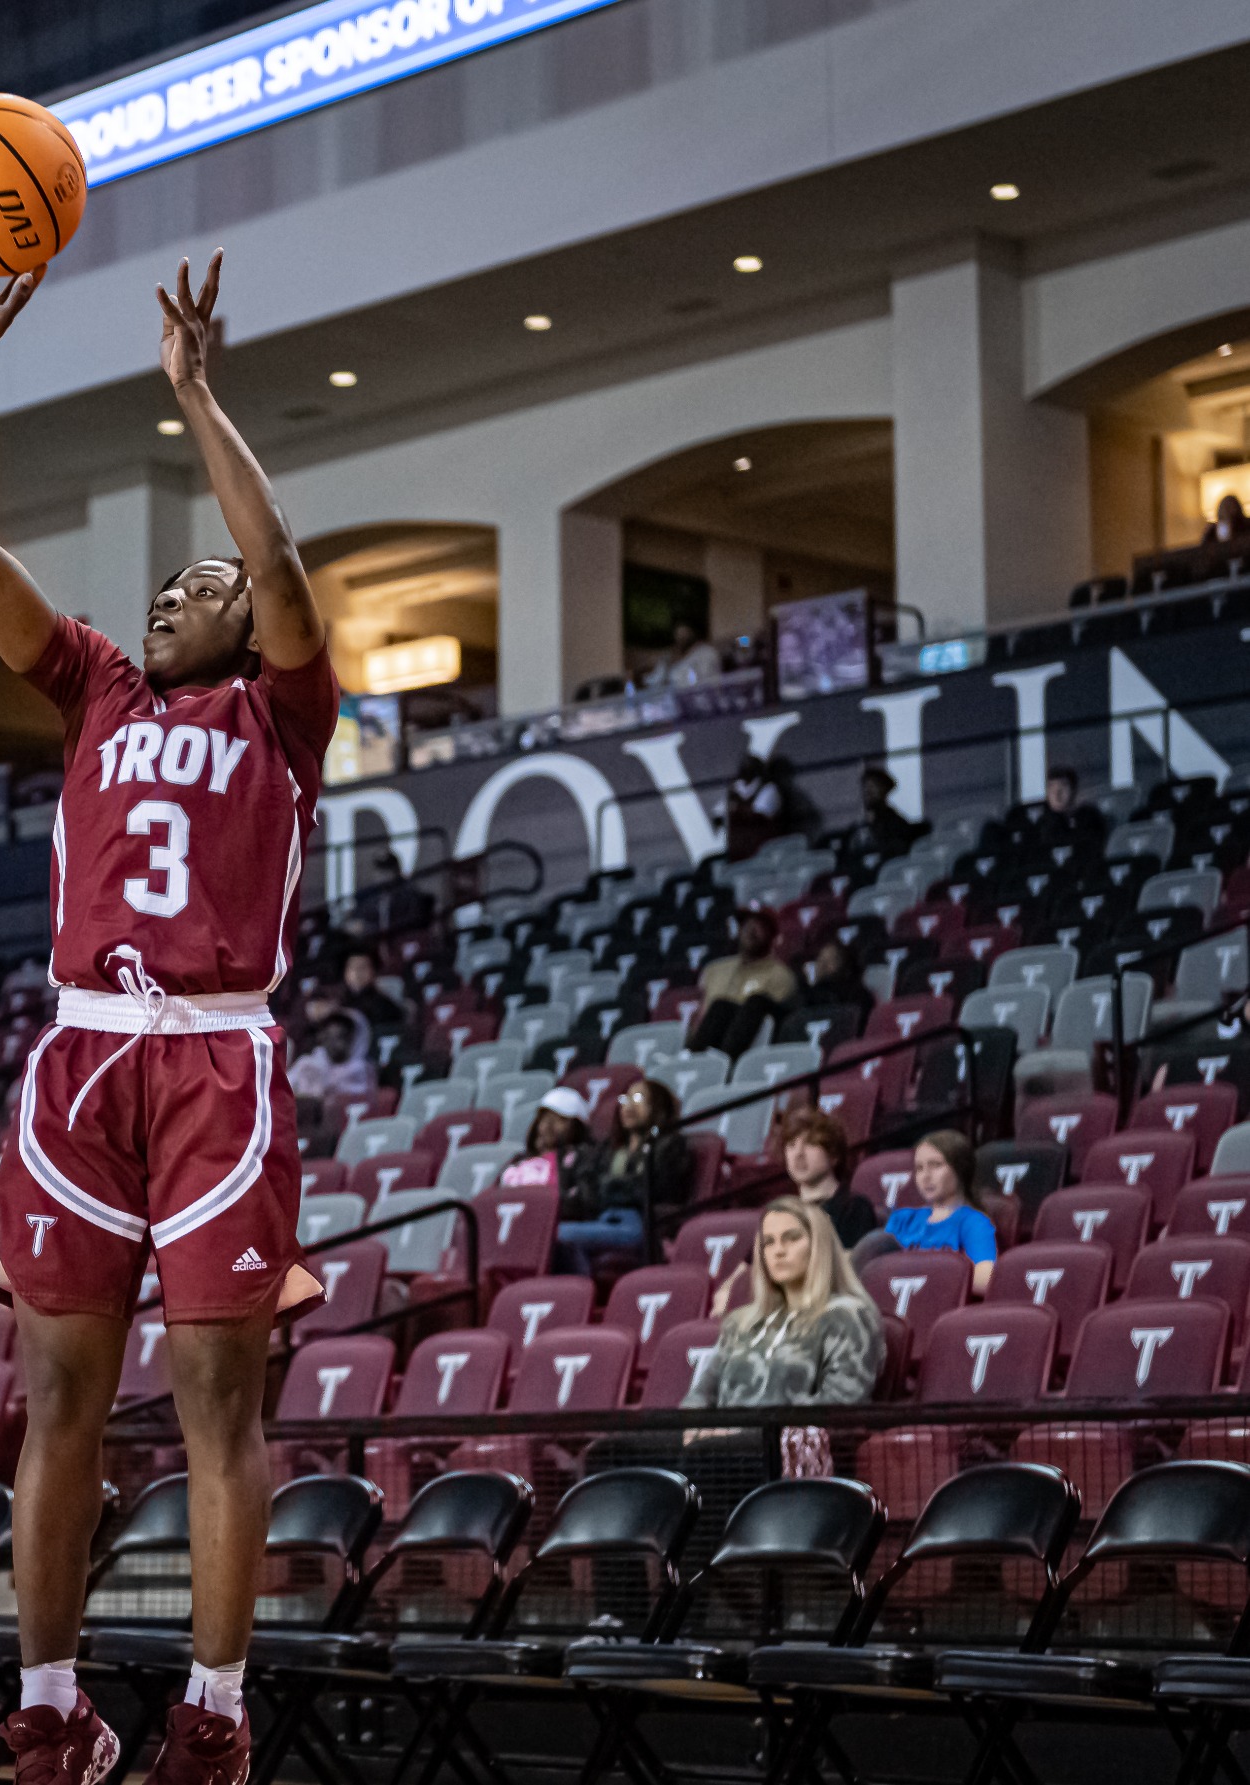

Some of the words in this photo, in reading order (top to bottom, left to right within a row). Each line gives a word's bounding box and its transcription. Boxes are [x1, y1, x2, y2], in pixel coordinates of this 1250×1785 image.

[168, 56, 262, 131] BEER
[264, 0, 450, 94] SPONSOR
[97, 721, 250, 794] TROY
[123, 800, 190, 918] 3
[25, 1213, 58, 1258] T
[231, 1261, 268, 1272] adidas
